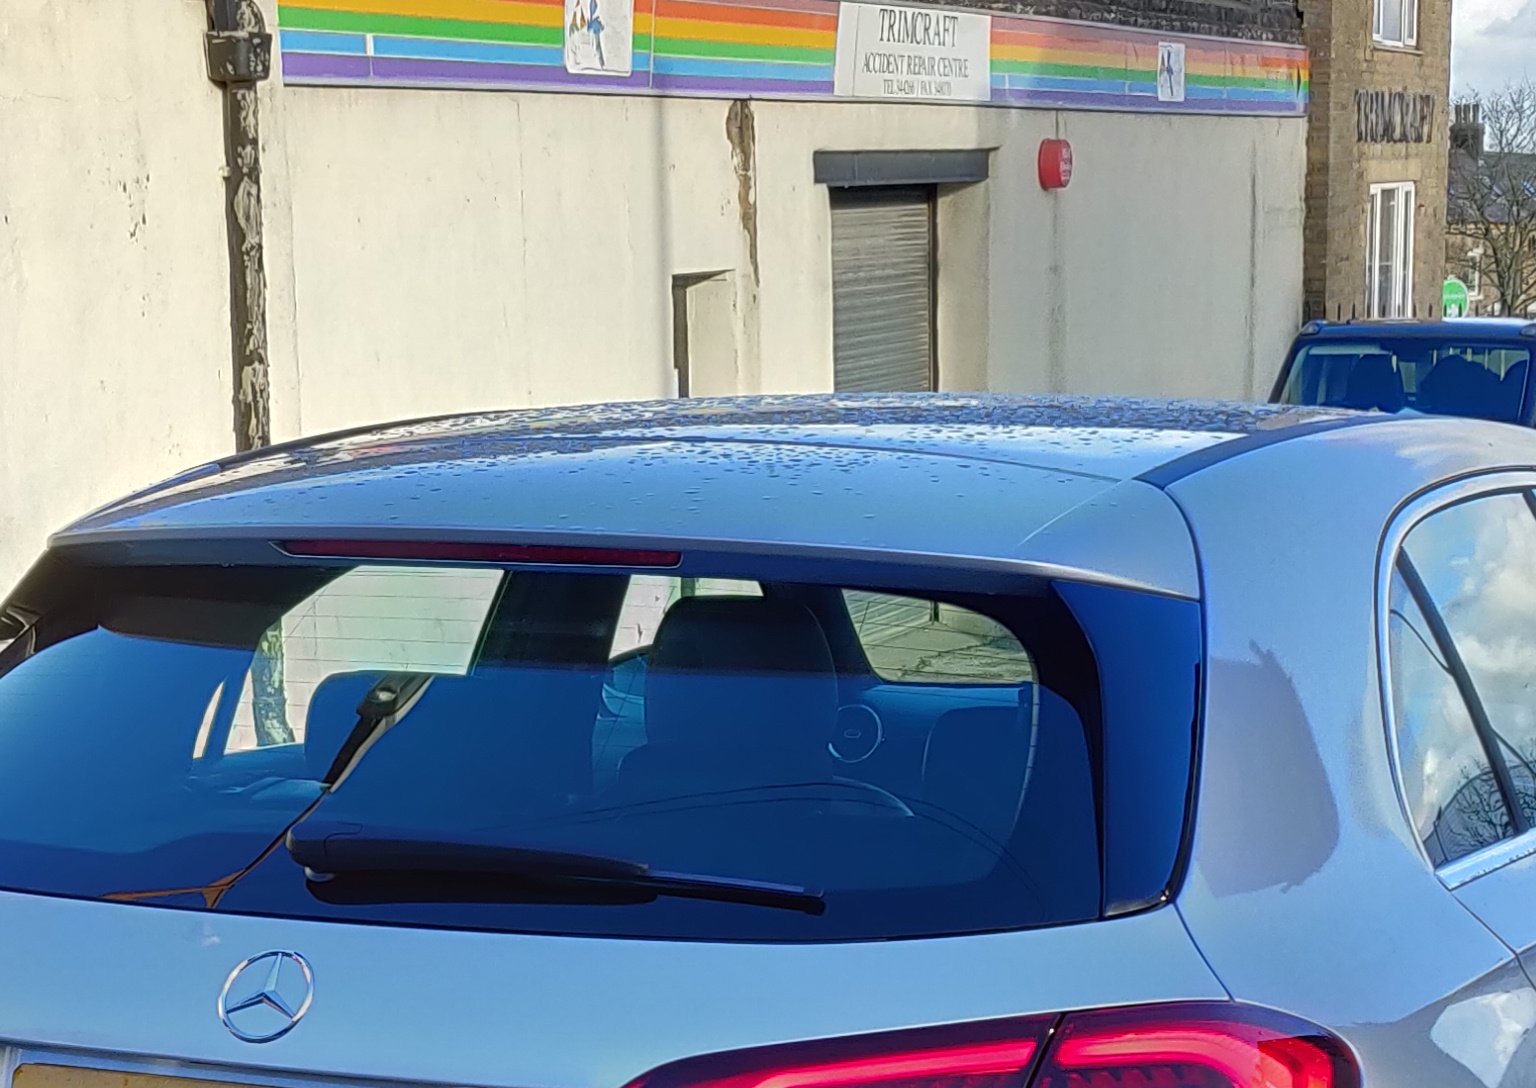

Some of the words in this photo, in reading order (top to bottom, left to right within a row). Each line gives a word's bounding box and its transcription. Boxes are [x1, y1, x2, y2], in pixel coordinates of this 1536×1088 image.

[878, 8, 958, 47] TRIMCRAFT
[863, 52, 905, 75] ACCIDENT
[907, 55, 936, 77] REPAIR
[937, 57, 969, 78] CENTRE
